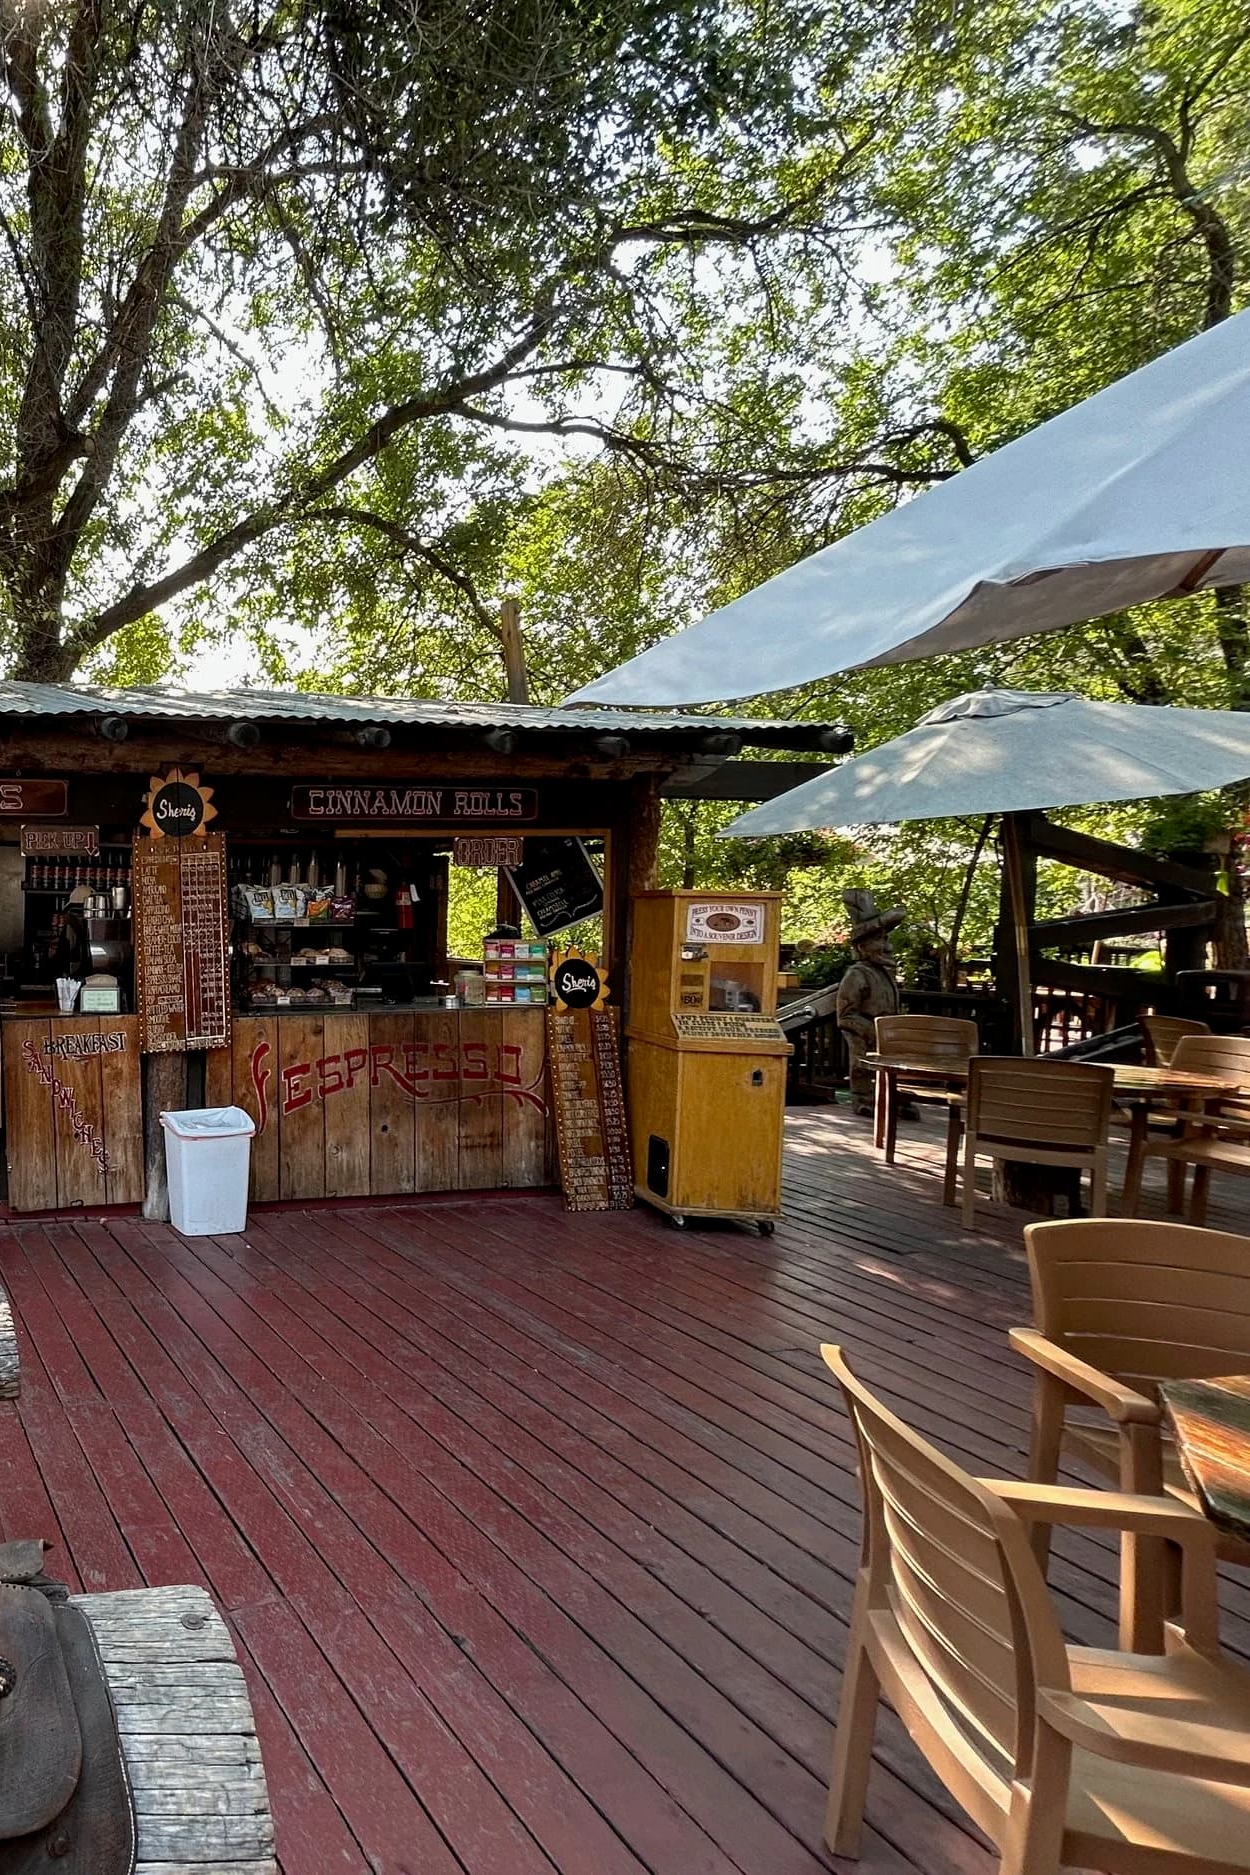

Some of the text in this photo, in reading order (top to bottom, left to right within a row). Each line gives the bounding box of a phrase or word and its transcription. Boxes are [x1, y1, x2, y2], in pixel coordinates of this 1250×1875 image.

[308, 789, 522, 816] CINNAMON ROLLS
[24, 830, 85, 850] PICK UP
[457, 838, 521, 866] ORDER
[692, 906, 709, 918] PRESS
[740, 907, 757, 919] PENNY
[691, 927, 704, 938] INTO
[708, 933, 736, 941] SOUVENIR
[736, 928, 757, 939] DESIGN
[42, 1031, 127, 1061] BREAKFAST
[281, 1042, 523, 1116] ESPRESSO
[21, 1039, 111, 1174] SANDWICHES
